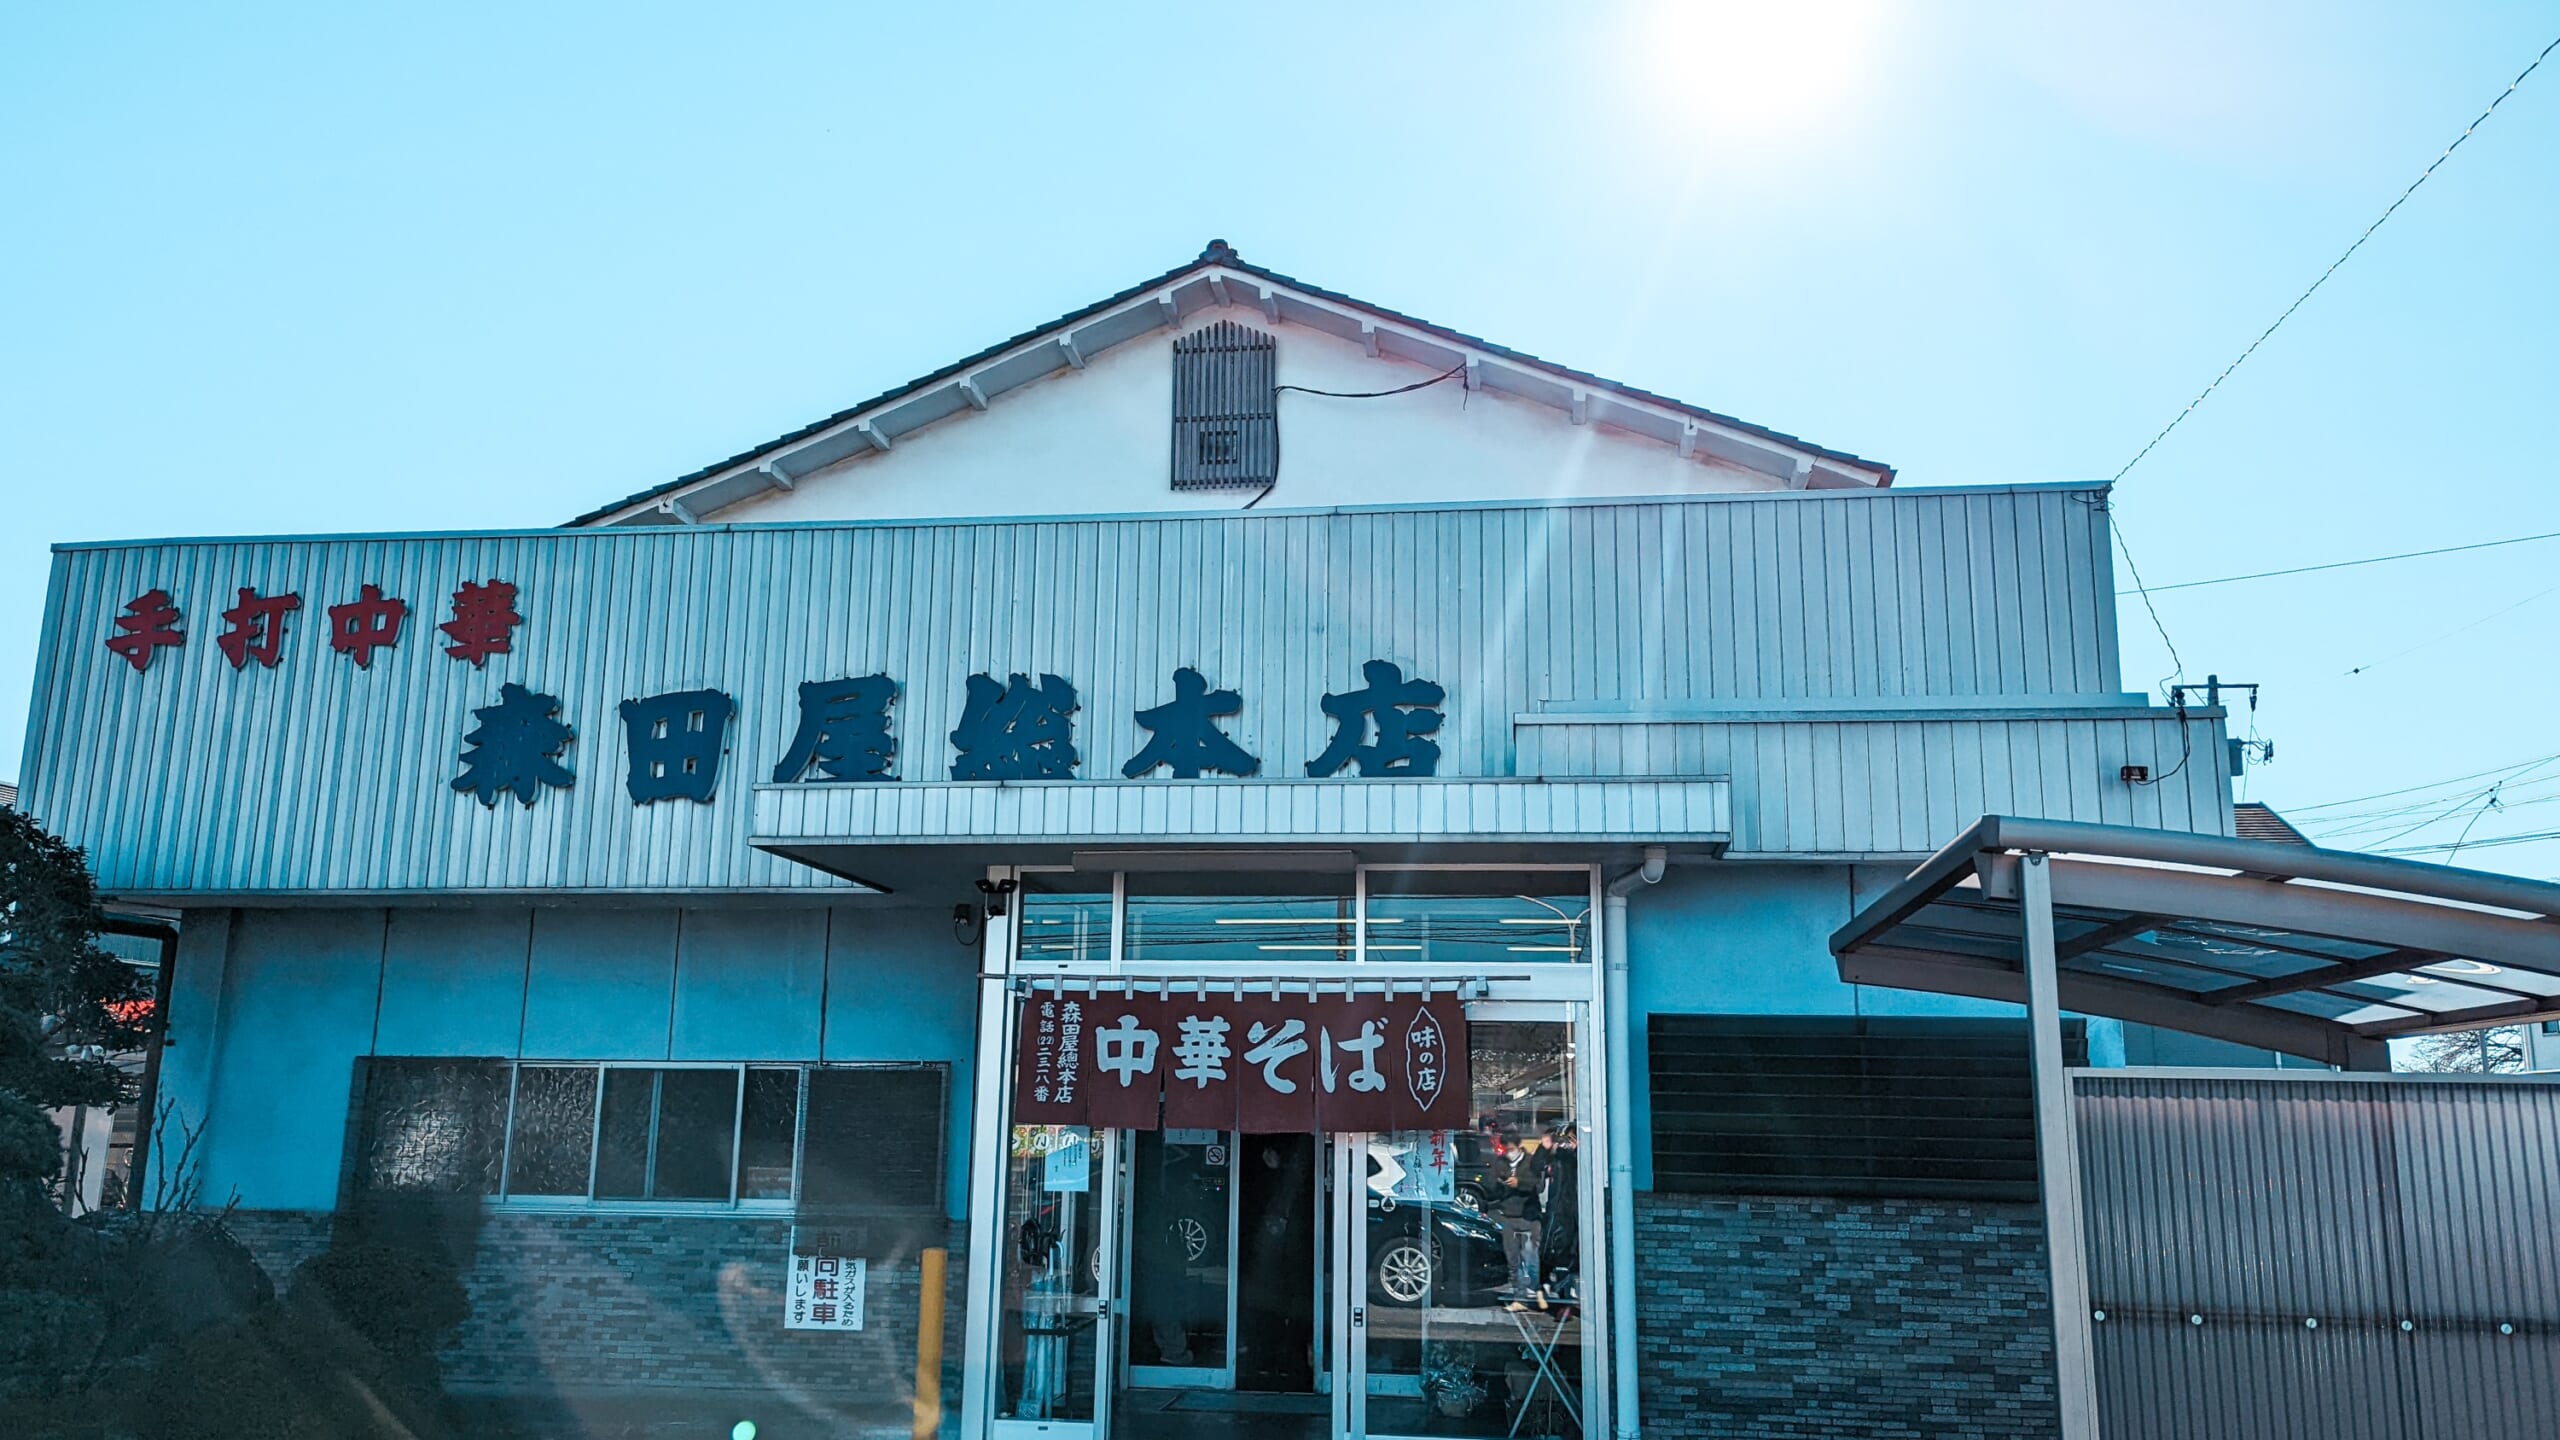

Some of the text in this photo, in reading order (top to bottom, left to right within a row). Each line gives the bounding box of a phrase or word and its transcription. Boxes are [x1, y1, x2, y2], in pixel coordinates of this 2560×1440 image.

[106, 579, 521, 671] 手打中華
[1095, 1014, 1390, 1095] 中華そば
[1411, 1026, 1438, 1092] 味の店
